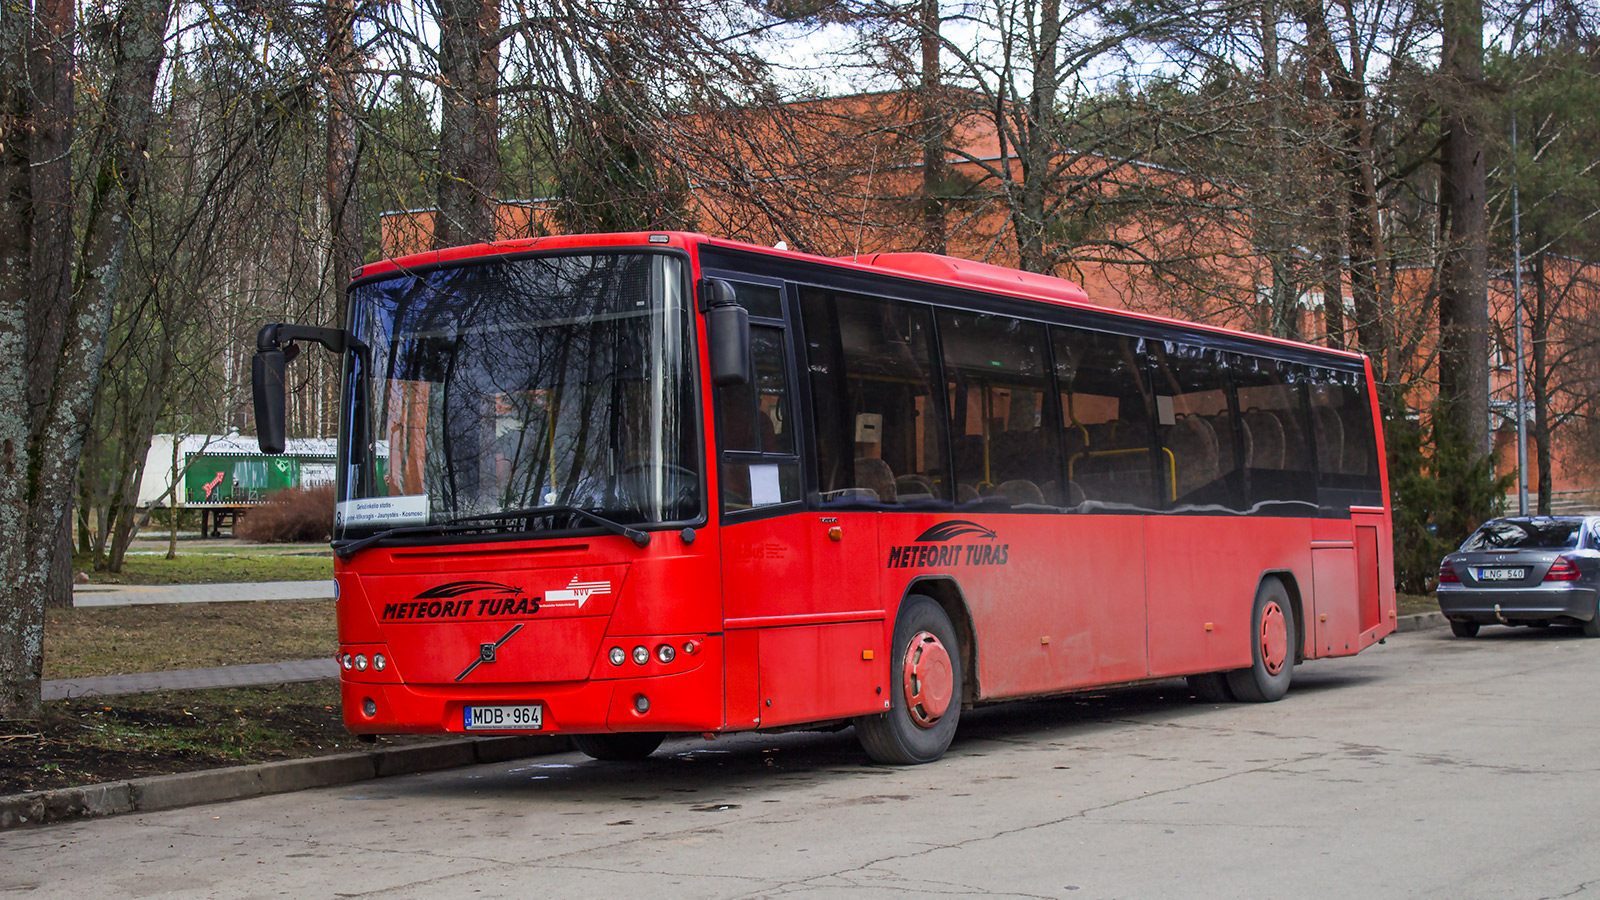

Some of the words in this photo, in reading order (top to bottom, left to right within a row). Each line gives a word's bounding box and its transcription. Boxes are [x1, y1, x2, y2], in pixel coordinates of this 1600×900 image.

[336, 511, 342, 526] 8
[886, 545, 963, 569] METEORIT
[965, 544, 1009, 566] TURAS
[1483, 569, 1502, 578] LNG
[1507, 569, 1524, 578] 540
[382, 599, 474, 620] METEORIT
[477, 597, 541, 616] TURAS
[473, 708, 504, 724] MDB
[513, 708, 539, 724] 964
